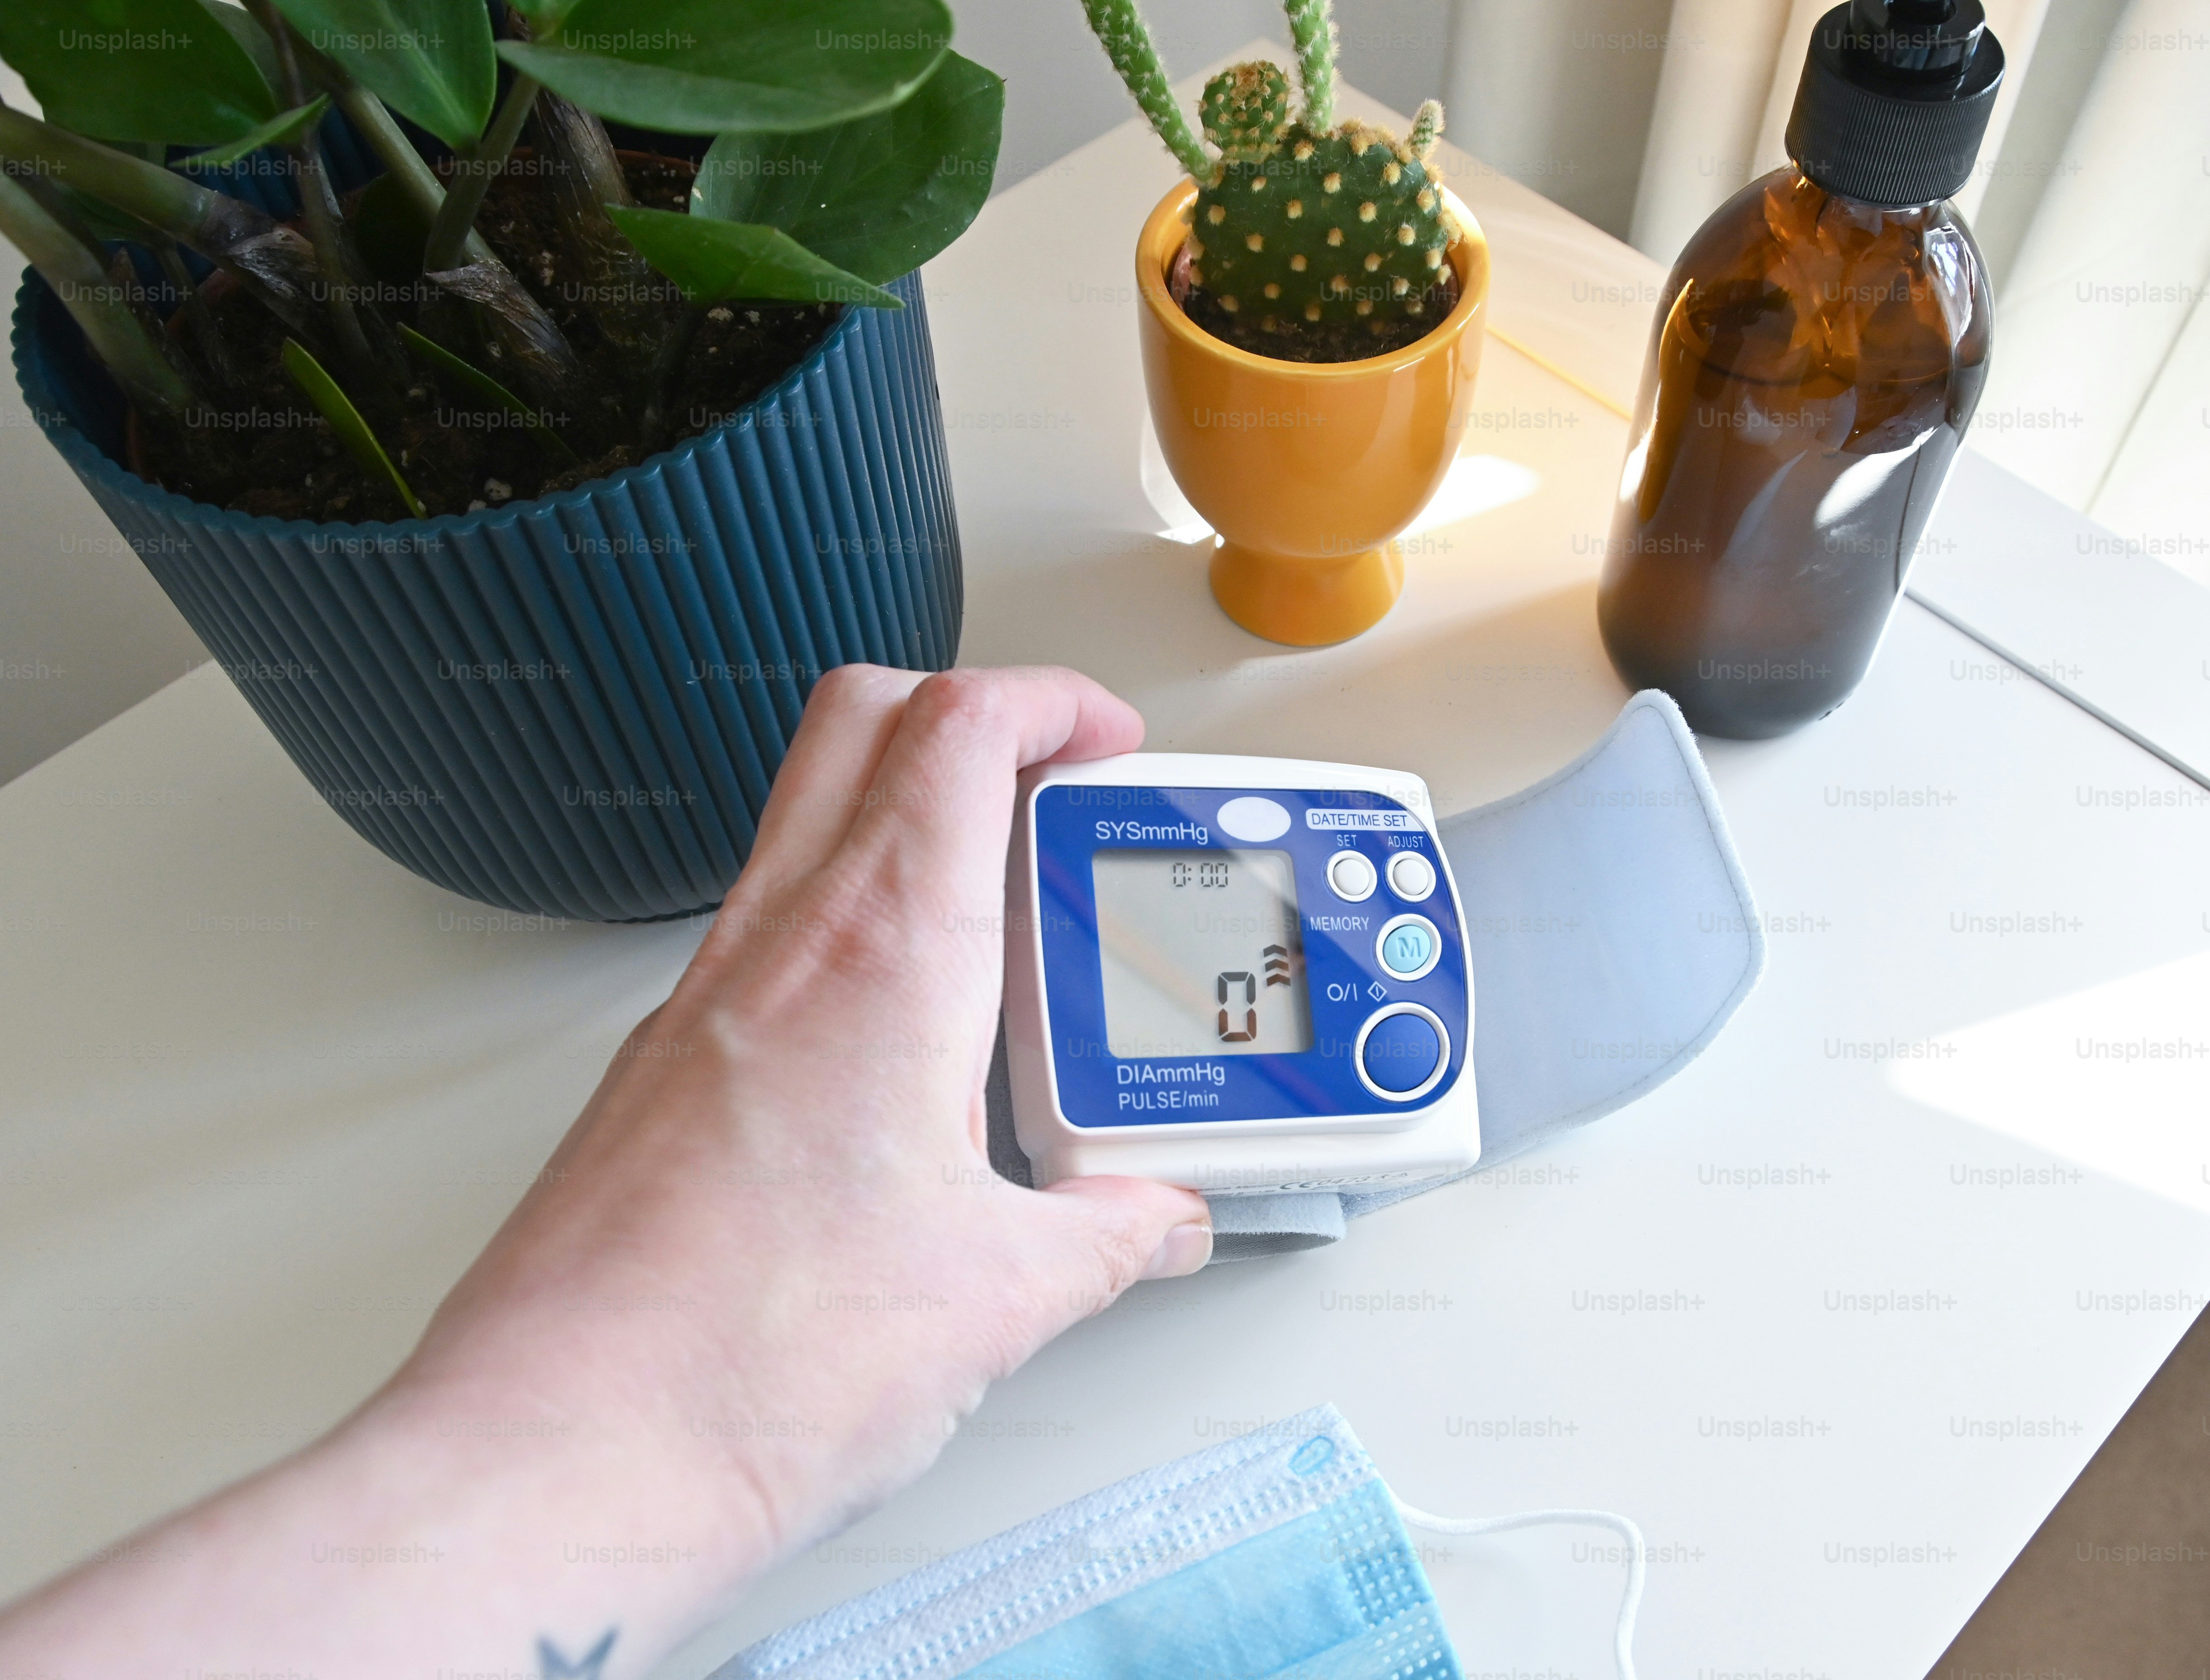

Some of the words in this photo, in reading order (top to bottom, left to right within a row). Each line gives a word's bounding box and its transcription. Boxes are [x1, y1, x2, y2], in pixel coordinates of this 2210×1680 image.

[1312, 813, 1380, 826] DATE/TIME
[1383, 815, 1407, 826] SET
[1095, 821, 1208, 845] SYSmmHg
[1337, 835, 1357, 846] SET
[1388, 836, 1423, 848] ADJUST
[1173, 862, 1228, 888] 0:00
[1310, 916, 1369, 931] MEMORY
[1397, 936, 1422, 958] M
[1217, 971, 1257, 1042] 0
[1117, 1062, 1225, 1086] DIAmmHg
[1119, 1090, 1219, 1110] PULSE/min
